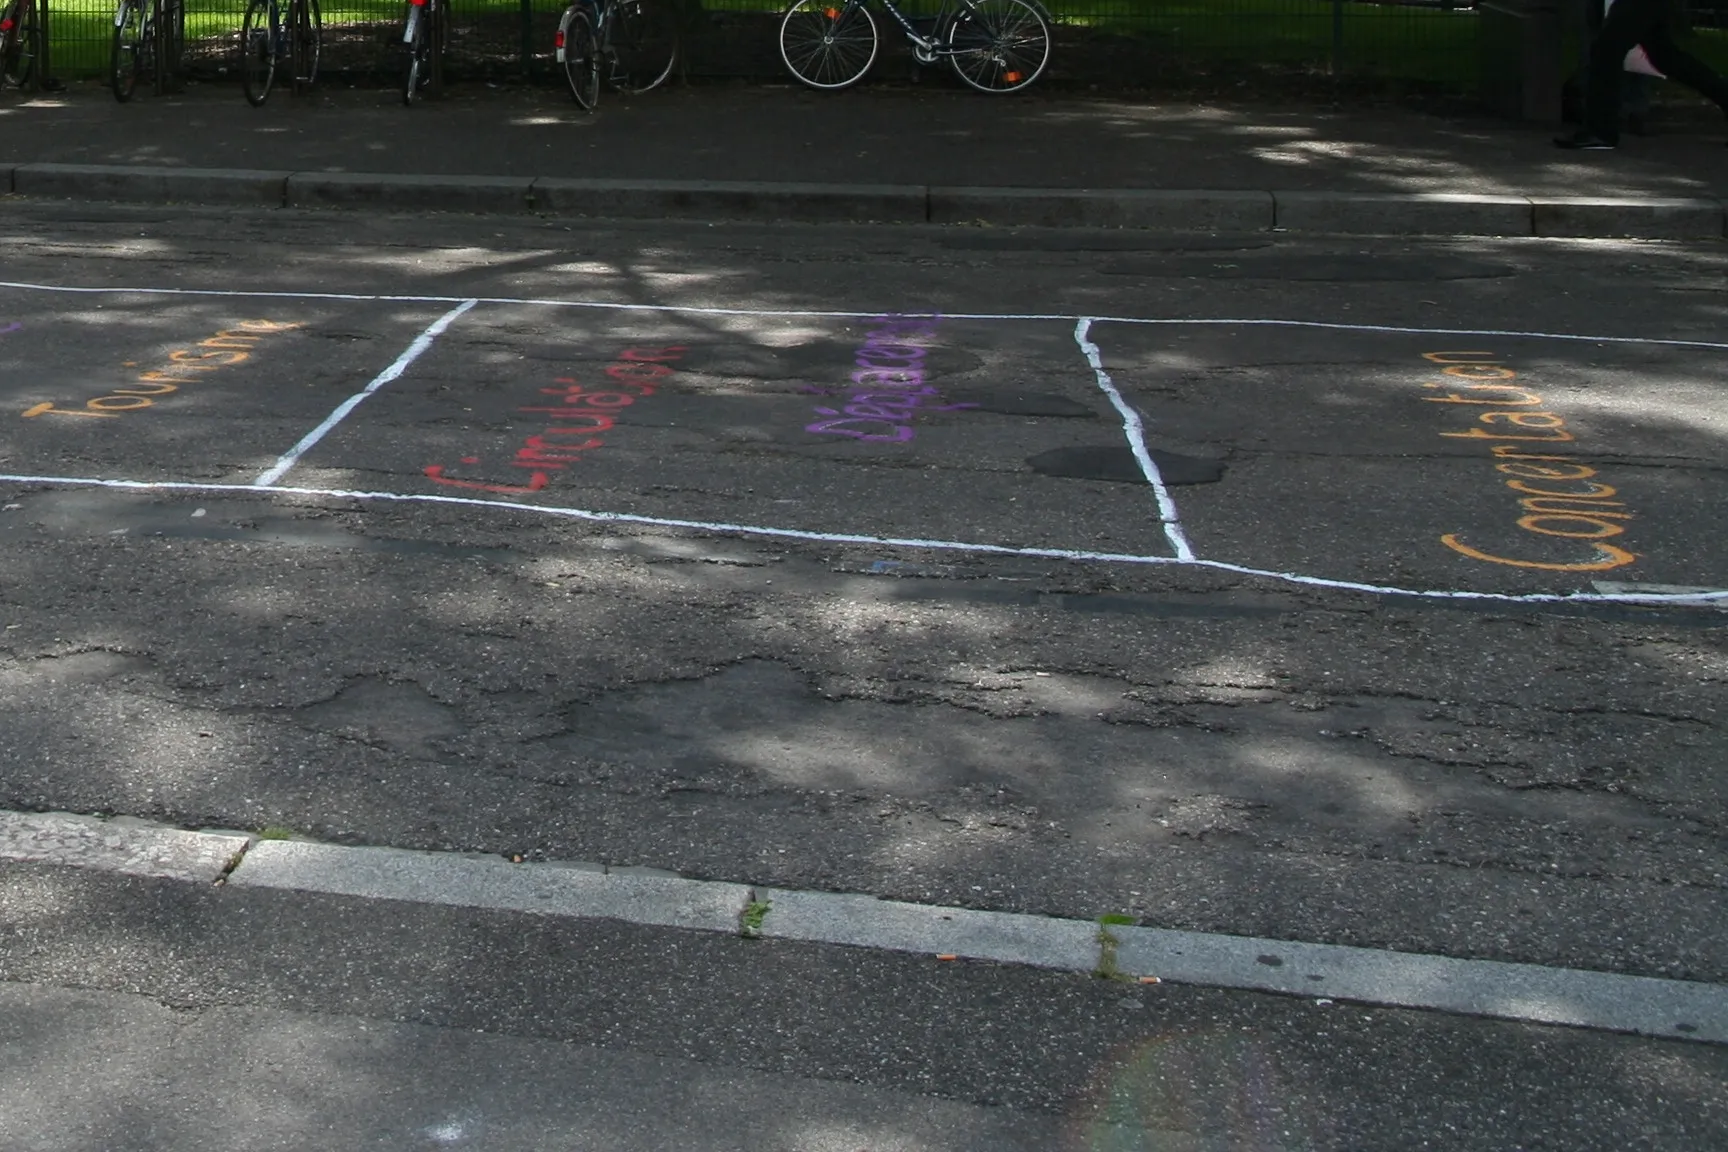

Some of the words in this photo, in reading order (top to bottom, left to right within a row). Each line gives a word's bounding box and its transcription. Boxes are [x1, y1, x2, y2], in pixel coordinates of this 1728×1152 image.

[21, 319, 304, 418] Tourisme
[423, 345, 689, 494] Circulation
[1420, 350, 1638, 571] Concertation
